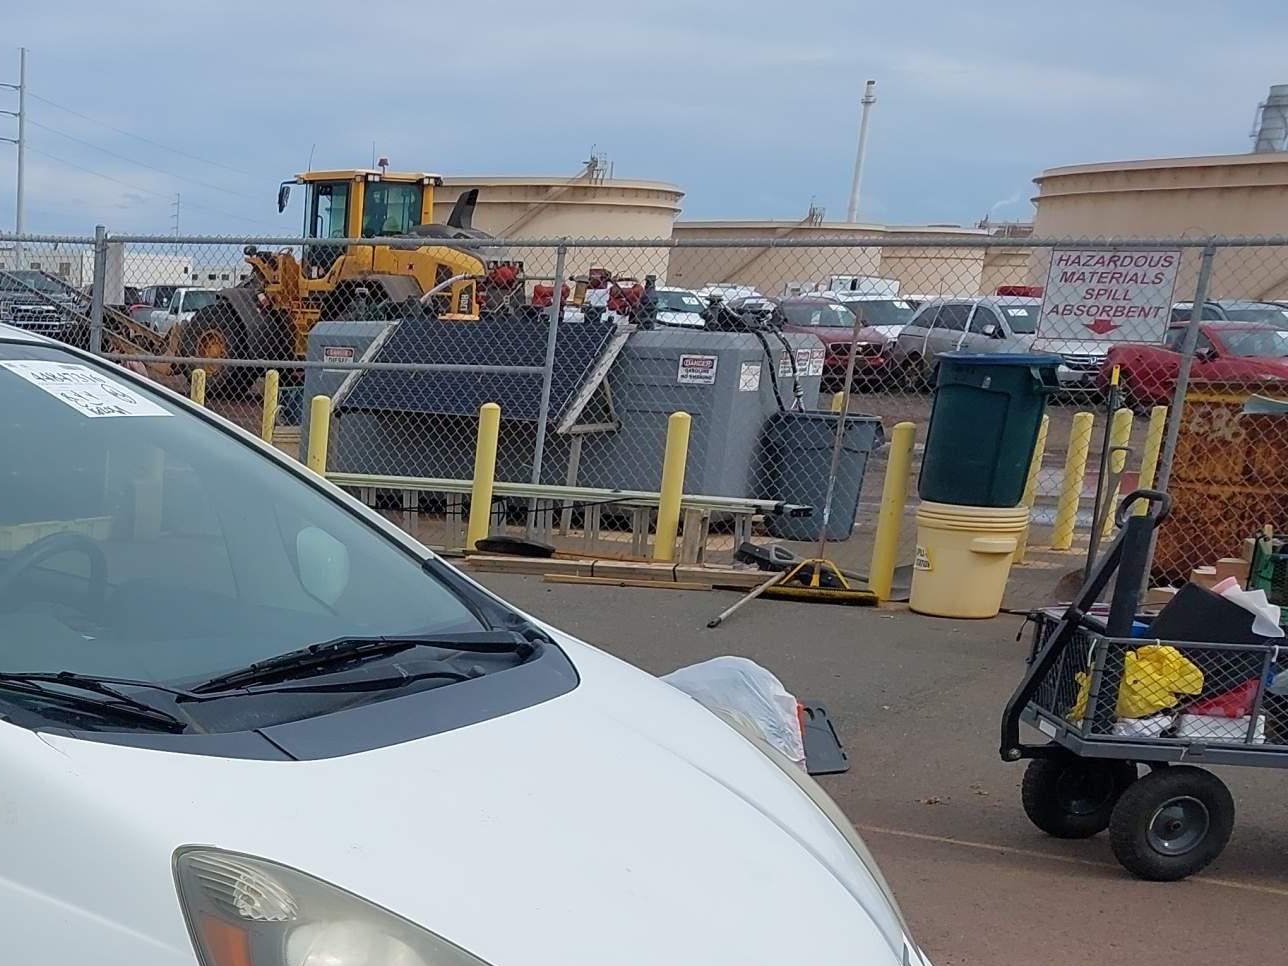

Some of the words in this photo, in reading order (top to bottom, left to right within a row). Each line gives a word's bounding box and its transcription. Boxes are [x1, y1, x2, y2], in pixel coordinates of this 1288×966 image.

[1056, 254, 1175, 269] HAZARDOUS
[1059, 271, 1165, 285] MATERIALS
[1083, 288, 1133, 301] SPILL
[1047, 304, 1164, 318] ABSORBENT
